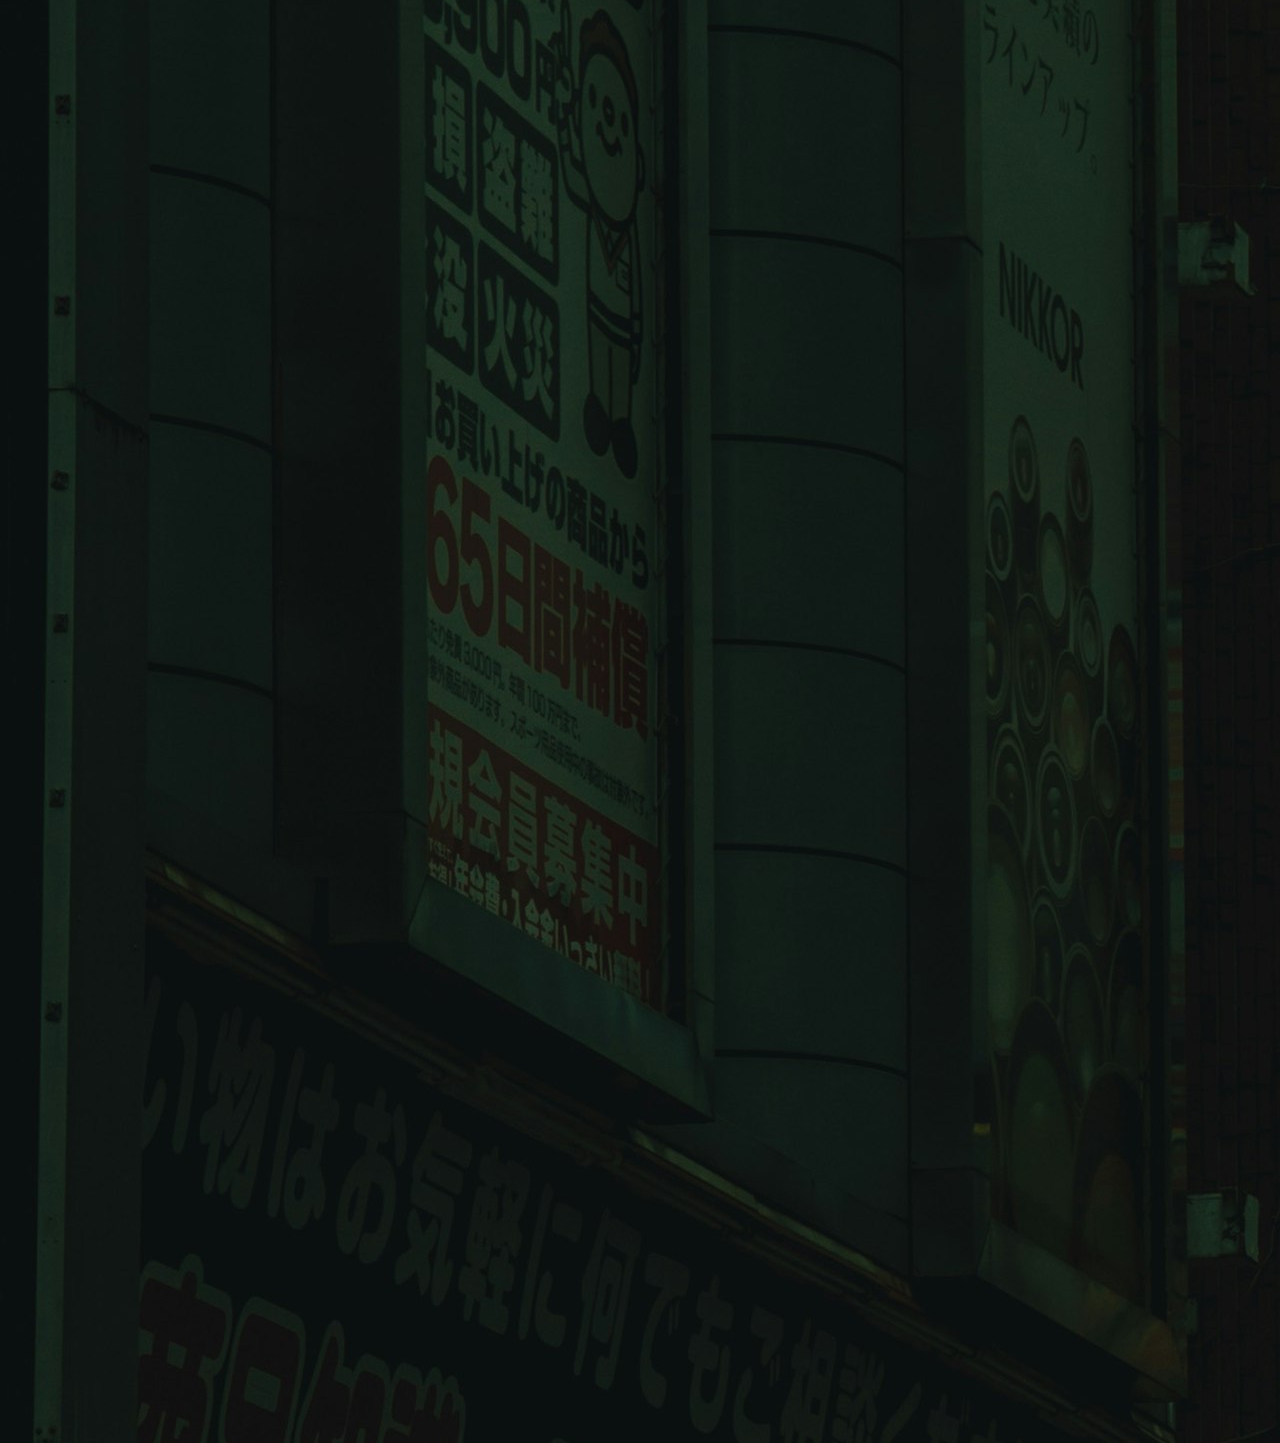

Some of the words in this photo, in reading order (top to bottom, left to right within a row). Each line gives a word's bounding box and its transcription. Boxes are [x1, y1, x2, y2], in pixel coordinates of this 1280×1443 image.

[983, 3, 1098, 176] ラインアップ。
[482, 273, 555, 421] 火災
[999, 240, 1085, 391] NIKKOR
[427, 455, 649, 743] 65日間補償
[428, 719, 649, 948] 規会員募集中
